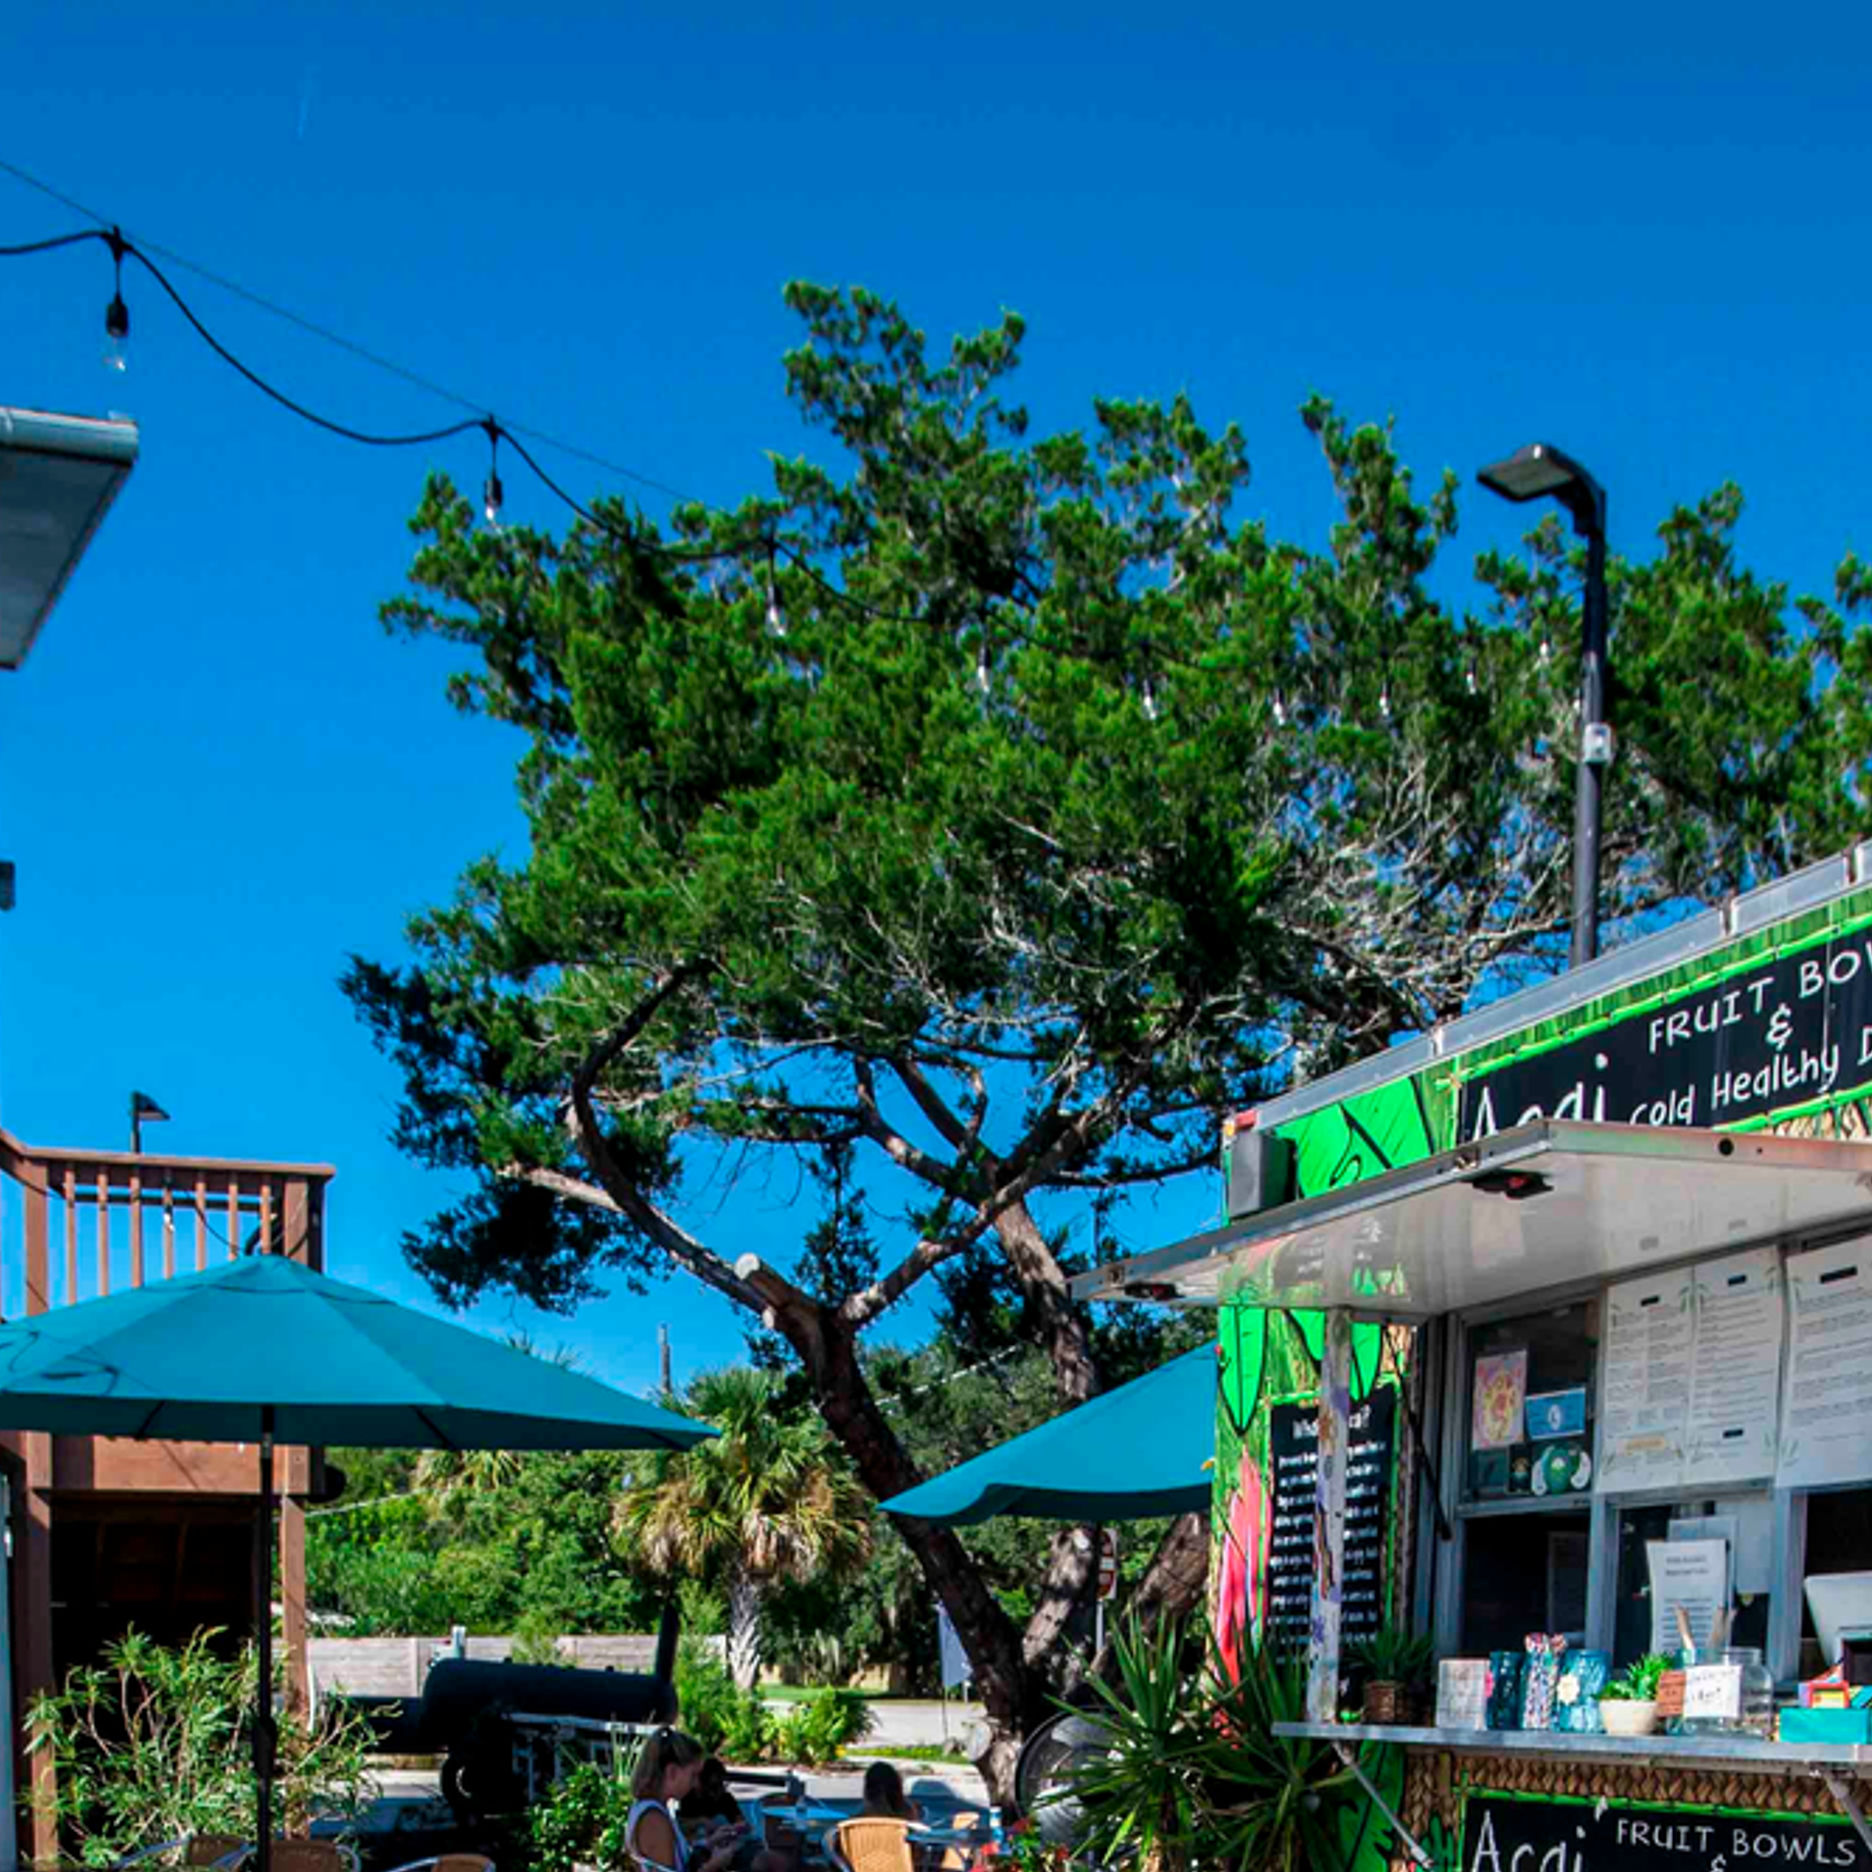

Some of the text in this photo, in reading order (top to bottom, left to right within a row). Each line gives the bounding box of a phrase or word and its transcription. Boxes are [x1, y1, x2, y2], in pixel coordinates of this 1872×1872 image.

[1649, 976, 1774, 1054] FRUIT
[1765, 1003, 1792, 1051] &
[1711, 1044, 1841, 1110] Healthy
[1616, 1819, 1856, 1866] FRUIT BOWLS
